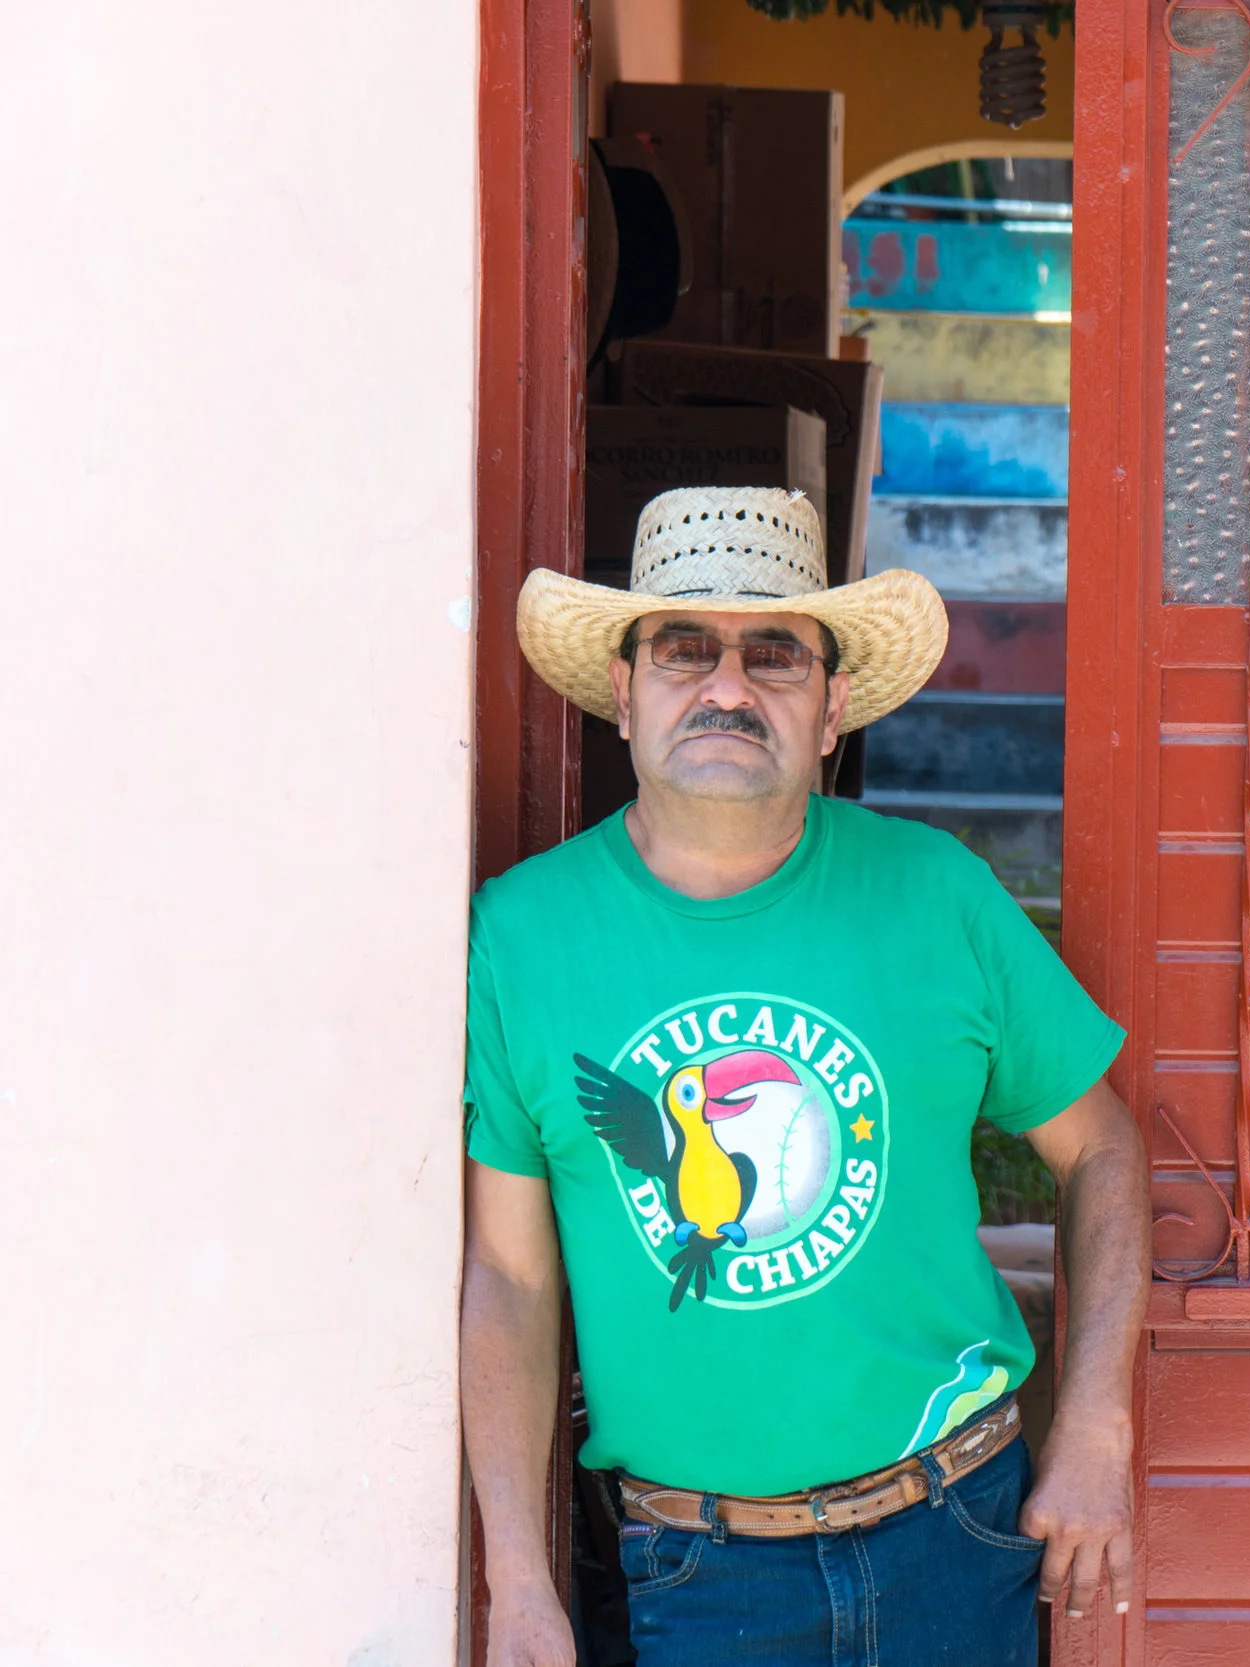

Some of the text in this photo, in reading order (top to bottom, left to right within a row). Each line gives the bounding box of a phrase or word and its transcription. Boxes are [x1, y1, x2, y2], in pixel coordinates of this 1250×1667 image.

[631, 1004, 874, 1109] TUCANES
[628, 1158, 879, 1294] DE CHIAPAS
